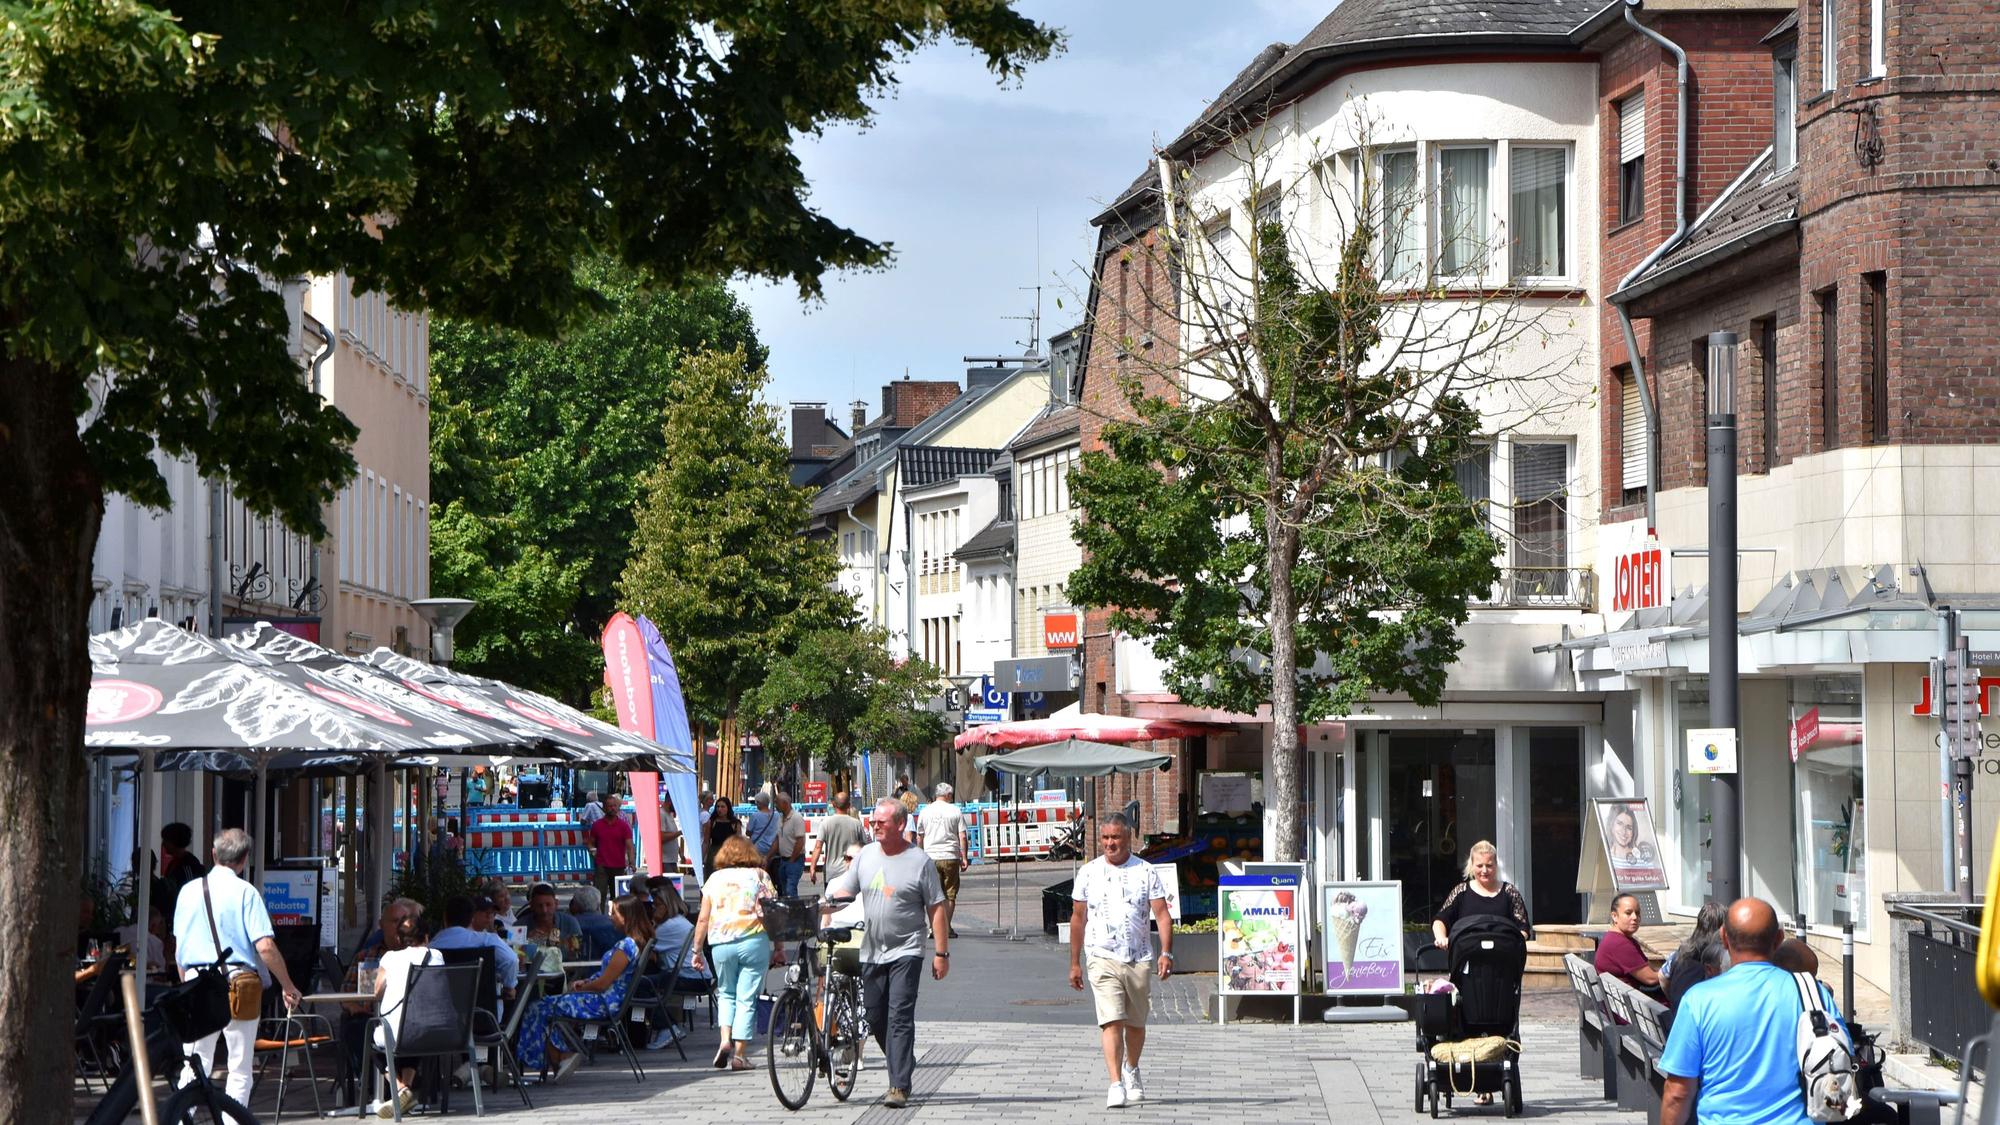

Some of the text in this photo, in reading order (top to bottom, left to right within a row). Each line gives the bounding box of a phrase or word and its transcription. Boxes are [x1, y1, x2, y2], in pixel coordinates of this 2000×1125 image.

[1972, 652, 1993, 660] Hotel
[264, 886, 287, 895] Mehr
[268, 902, 306, 910] Rabatte
[1243, 907, 1289, 916] AMALFI
[276, 917, 297, 926] alle!
